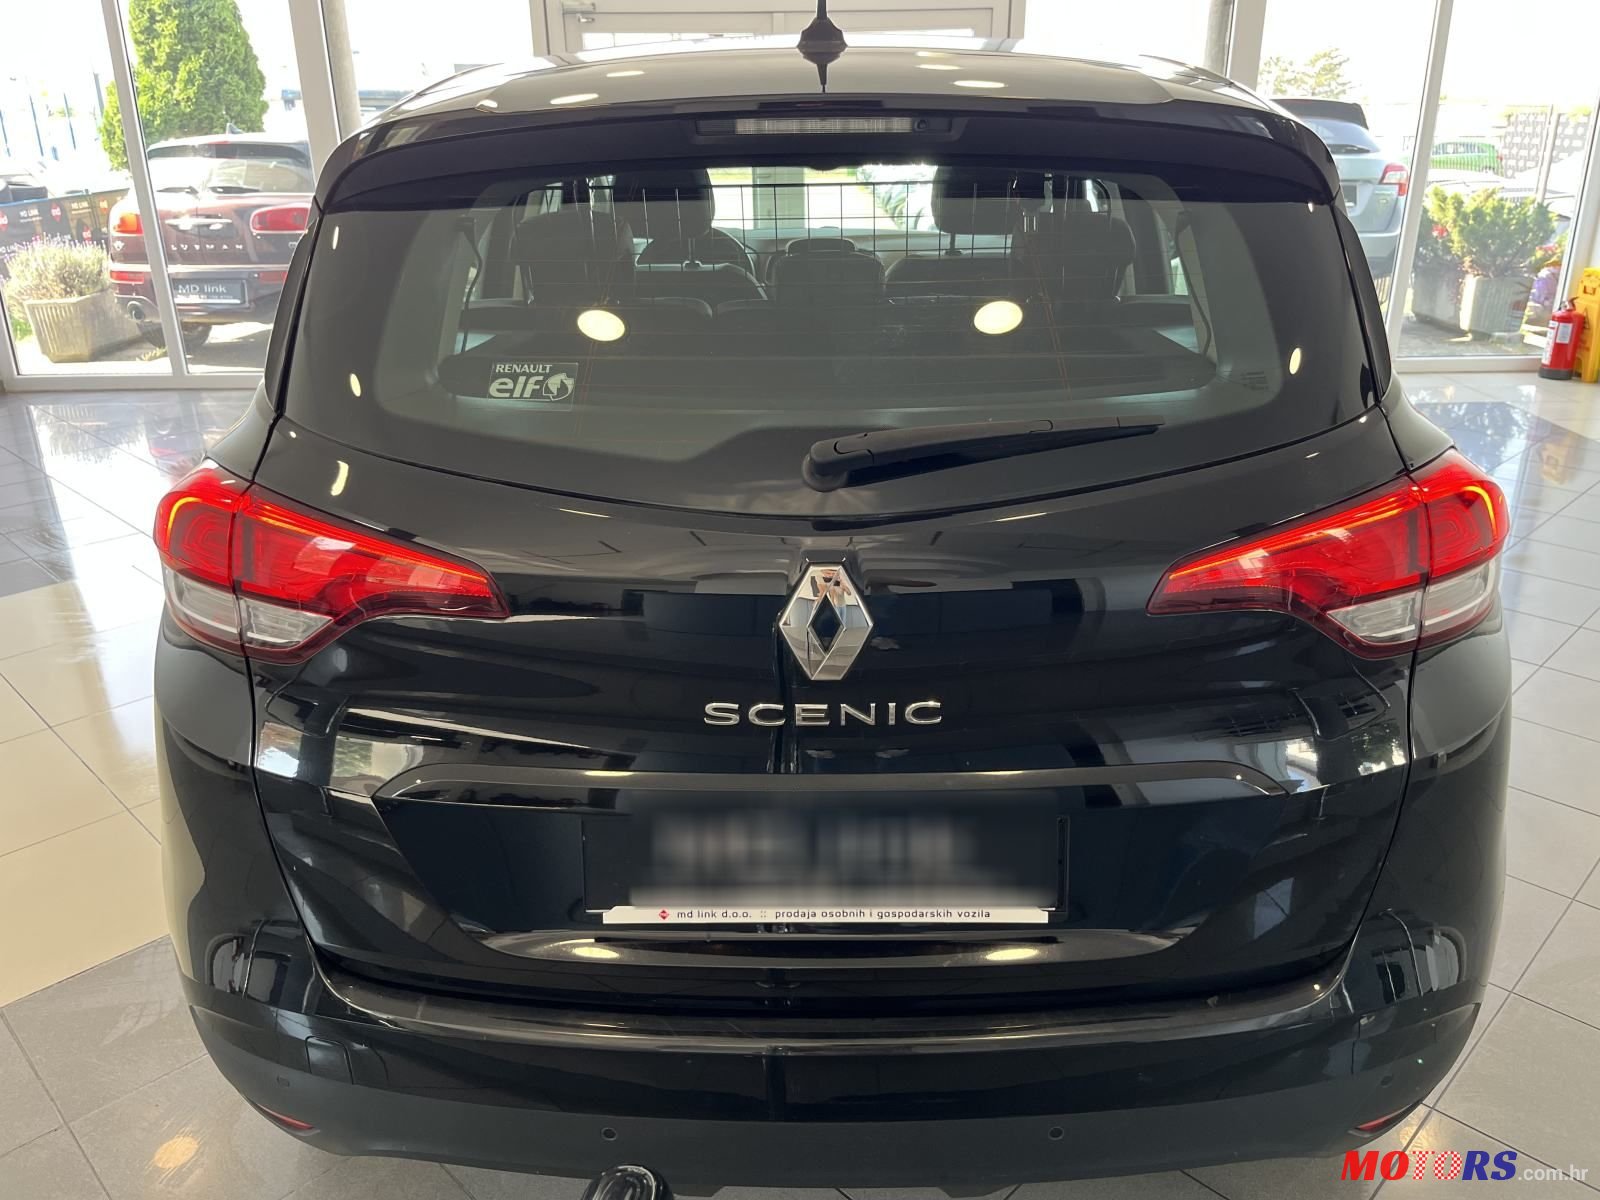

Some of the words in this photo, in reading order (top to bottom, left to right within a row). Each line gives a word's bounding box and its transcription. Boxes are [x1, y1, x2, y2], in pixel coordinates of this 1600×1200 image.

[178, 284, 200, 293] MD
[204, 284, 227, 293] link
[495, 364, 552, 373] RENAULT
[489, 375, 544, 398] elf
[703, 701, 942, 726] SCENIC
[677, 910, 693, 918] md
[698, 909, 717, 918] link
[722, 910, 752, 919] d.o.o.
[775, 909, 817, 920] prodaja
[821, 909, 865, 918] osobnih
[877, 909, 952, 920] gospodarskih
[957, 909, 990, 918] vozila
